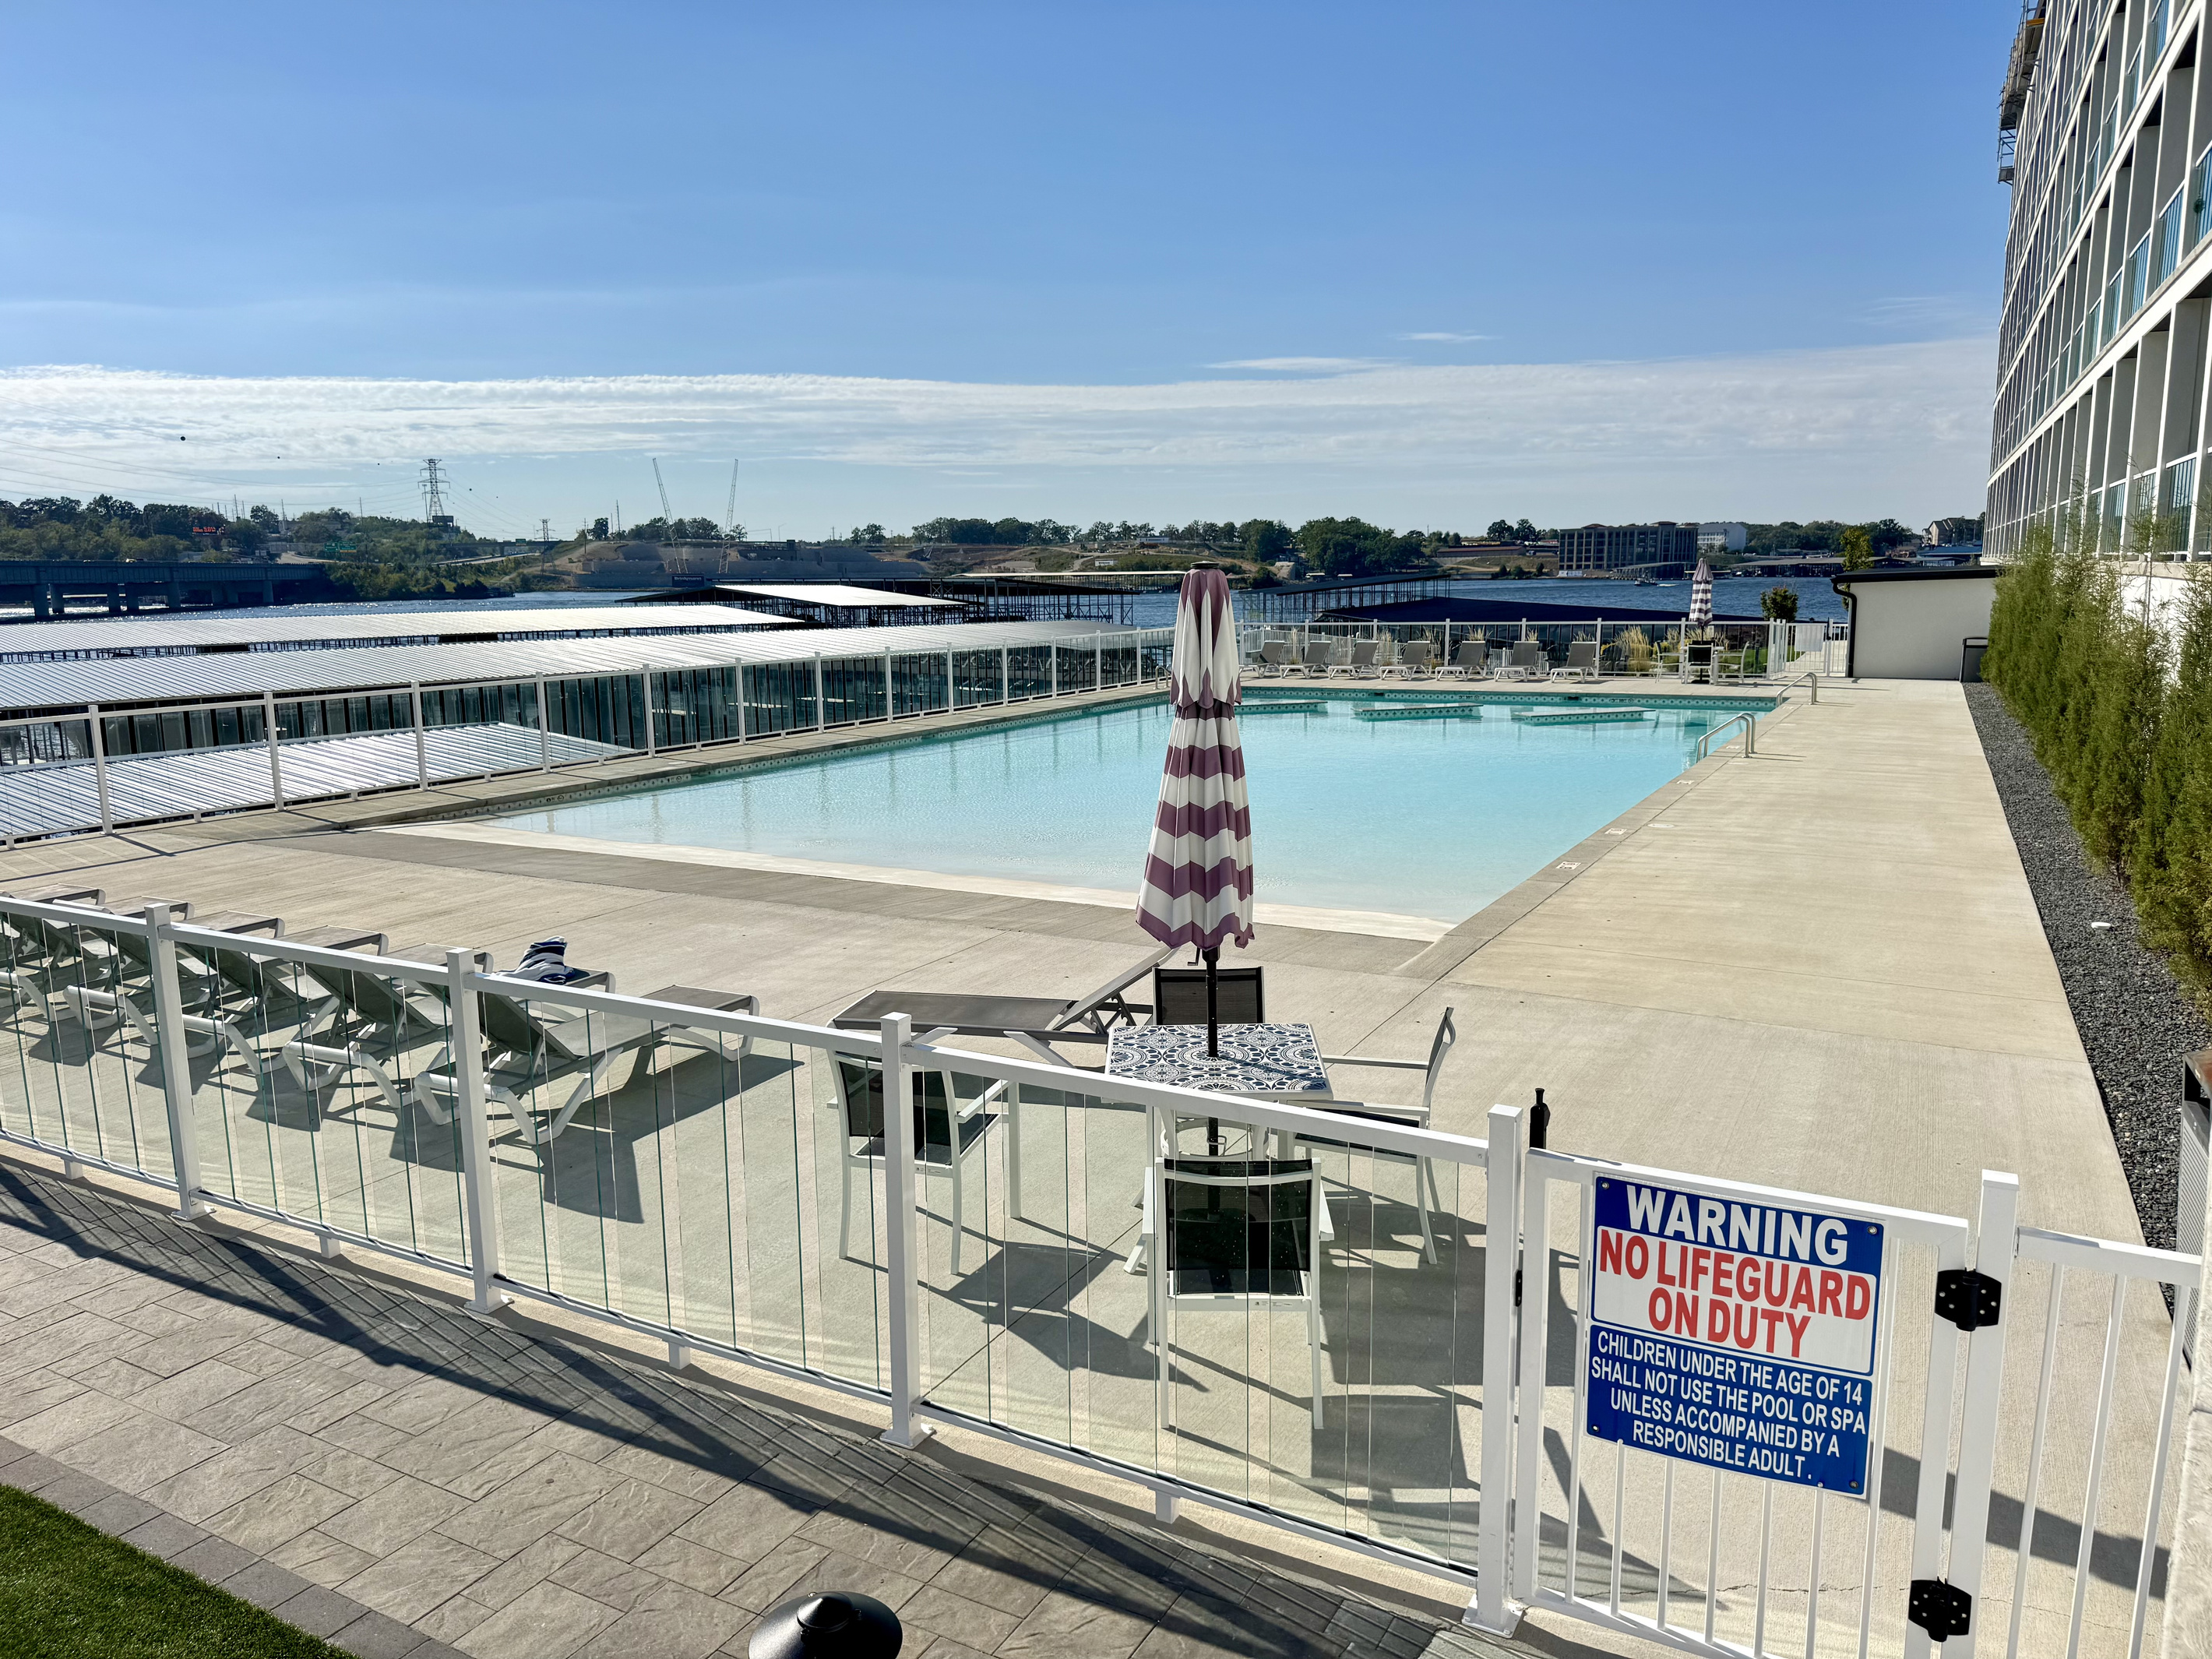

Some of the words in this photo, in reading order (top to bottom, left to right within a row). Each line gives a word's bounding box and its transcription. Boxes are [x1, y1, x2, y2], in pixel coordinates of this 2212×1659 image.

[1626, 1184, 1847, 1266] WARNING
[1599, 1228, 1649, 1280] NO
[1657, 1240, 1871, 1320] LIFEGUARD
[1648, 1287, 1700, 1338] ON
[1707, 1298, 1812, 1358] DUTY
[1591, 1356, 1641, 1389] SHALL
[1645, 1368, 1678, 1397] NOT
[1680, 1376, 1713, 1405] USE
[1716, 1384, 1749, 1413] THE
[1752, 1392, 1798, 1423] POOL
[1802, 1401, 1827, 1428] OR
[1830, 1407, 1866, 1435] SPA
[1597, 1330, 1677, 1369] CHILDREN
[1680, 1348, 1737, 1382] UNDER
[1740, 1361, 1773, 1390] THE
[1775, 1368, 1813, 1397] AGE
[1816, 1375, 1840, 1401] OF
[1844, 1381, 1862, 1406] 14
[1611, 1387, 1672, 1423] UNLESS
[1675, 1404, 1798, 1449] ACCOMPANIED
[1801, 1428, 1826, 1454] BY
[1826, 1434, 1840, 1458] A
[1633, 1419, 1745, 1467] RESPONSIBLE
